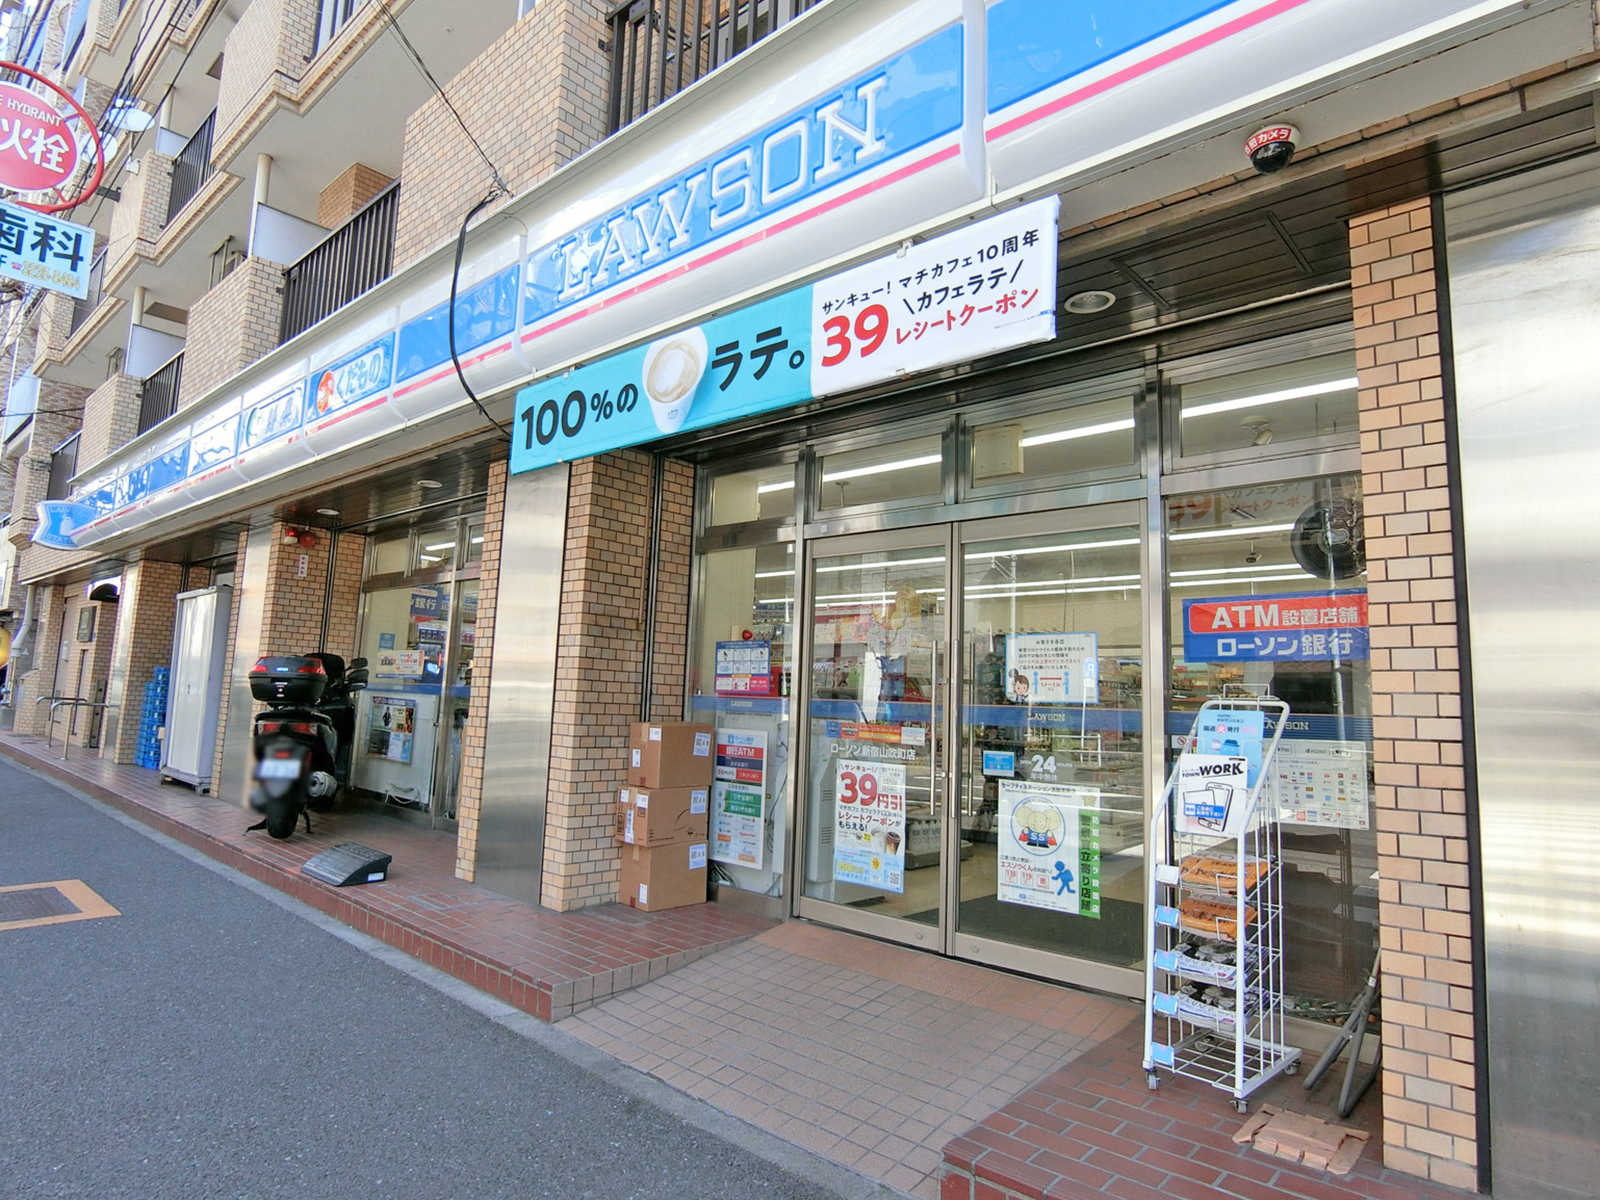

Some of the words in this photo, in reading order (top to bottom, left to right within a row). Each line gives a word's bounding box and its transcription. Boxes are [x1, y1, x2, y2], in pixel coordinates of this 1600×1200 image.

[7, 98, 61, 126] HYDRANT
[558, 70, 888, 302] LAWSON
[822, 280, 892, 315] サンキュー!
[899, 229, 1040, 289] マチカフェ10周年
[895, 288, 1039, 345] レシートクーポン
[821, 303, 889, 367] 39
[337, 353, 382, 404] くだもの
[521, 383, 639, 450] 100%の
[1217, 633, 1354, 657] ローソン銀行
[830, 743, 916, 760] ローソン新宿山吹町店
[1031, 754, 1057, 774] 24
[1199, 763, 1244, 776] WORK
[838, 810, 901, 827] レシートクーポンが
[838, 820, 868, 832] もらえる!
[1030, 832, 1046, 842] SS
